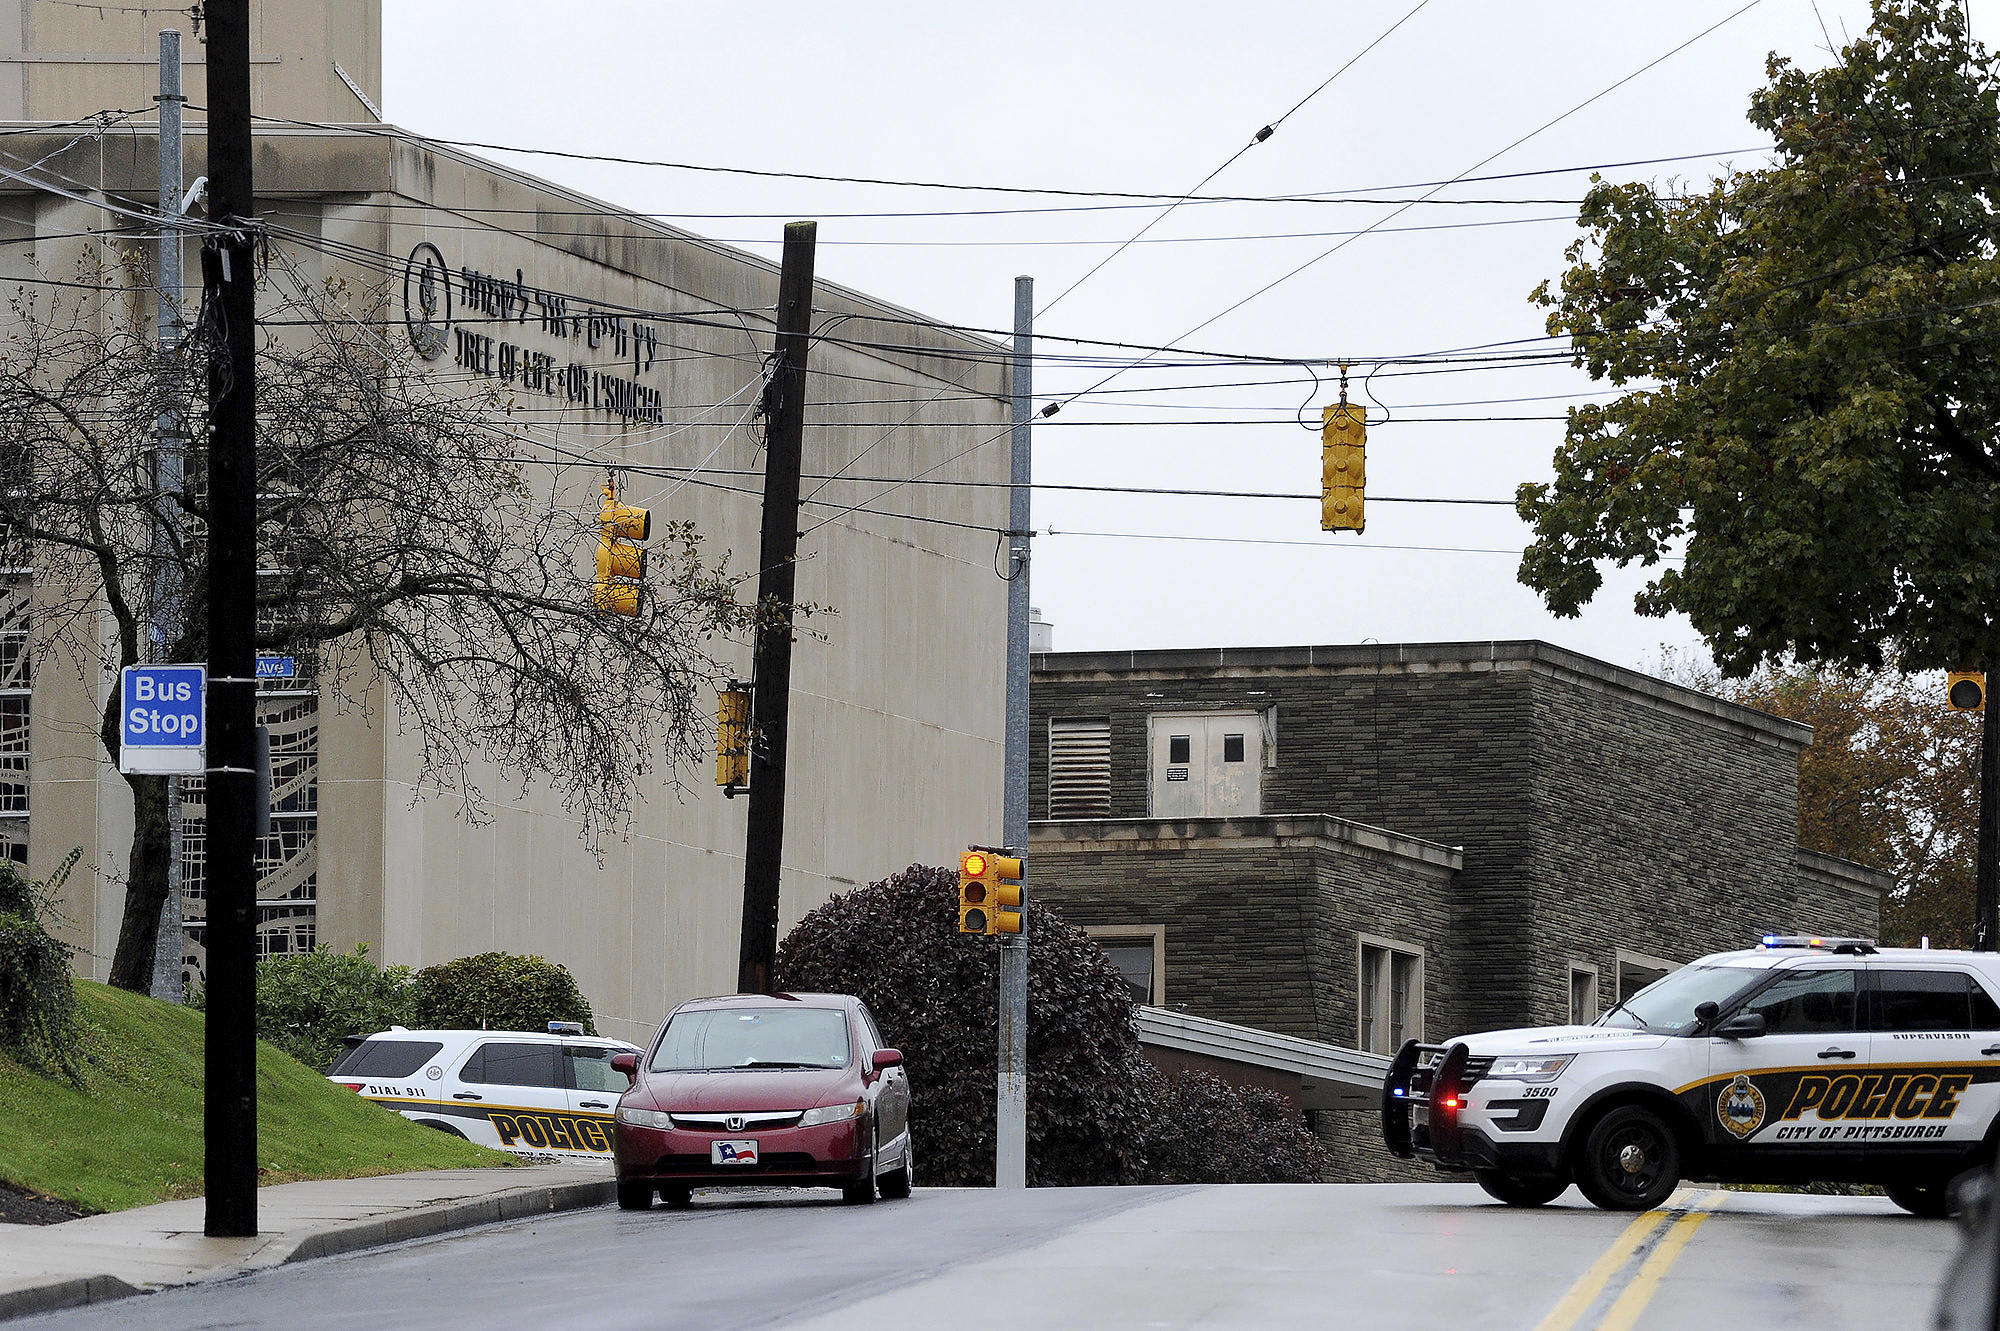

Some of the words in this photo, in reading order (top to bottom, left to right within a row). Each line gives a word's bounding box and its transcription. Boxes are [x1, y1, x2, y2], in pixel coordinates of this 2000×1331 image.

[633, 322, 659, 376] עץ
[455, 327, 495, 377] TREE
[499, 342, 520, 382] OF
[524, 349, 556, 395] LIFE
[567, 363, 589, 405] OR
[256, 660, 285, 675] Ave
[135, 676, 192, 701] Bus
[129, 708, 198, 738] Stop
[1892, 1033, 1971, 1041] SUPERVISOR
[369, 1085, 401, 1096] DIAL
[406, 1087, 426, 1097] 911
[1522, 1087, 1559, 1098] 3580
[1781, 1074, 1974, 1121] POLICE
[1776, 1126, 1817, 1140] CITY
[1819, 1126, 1842, 1139] OF
[1844, 1125, 1948, 1139] PITTSBURGH
